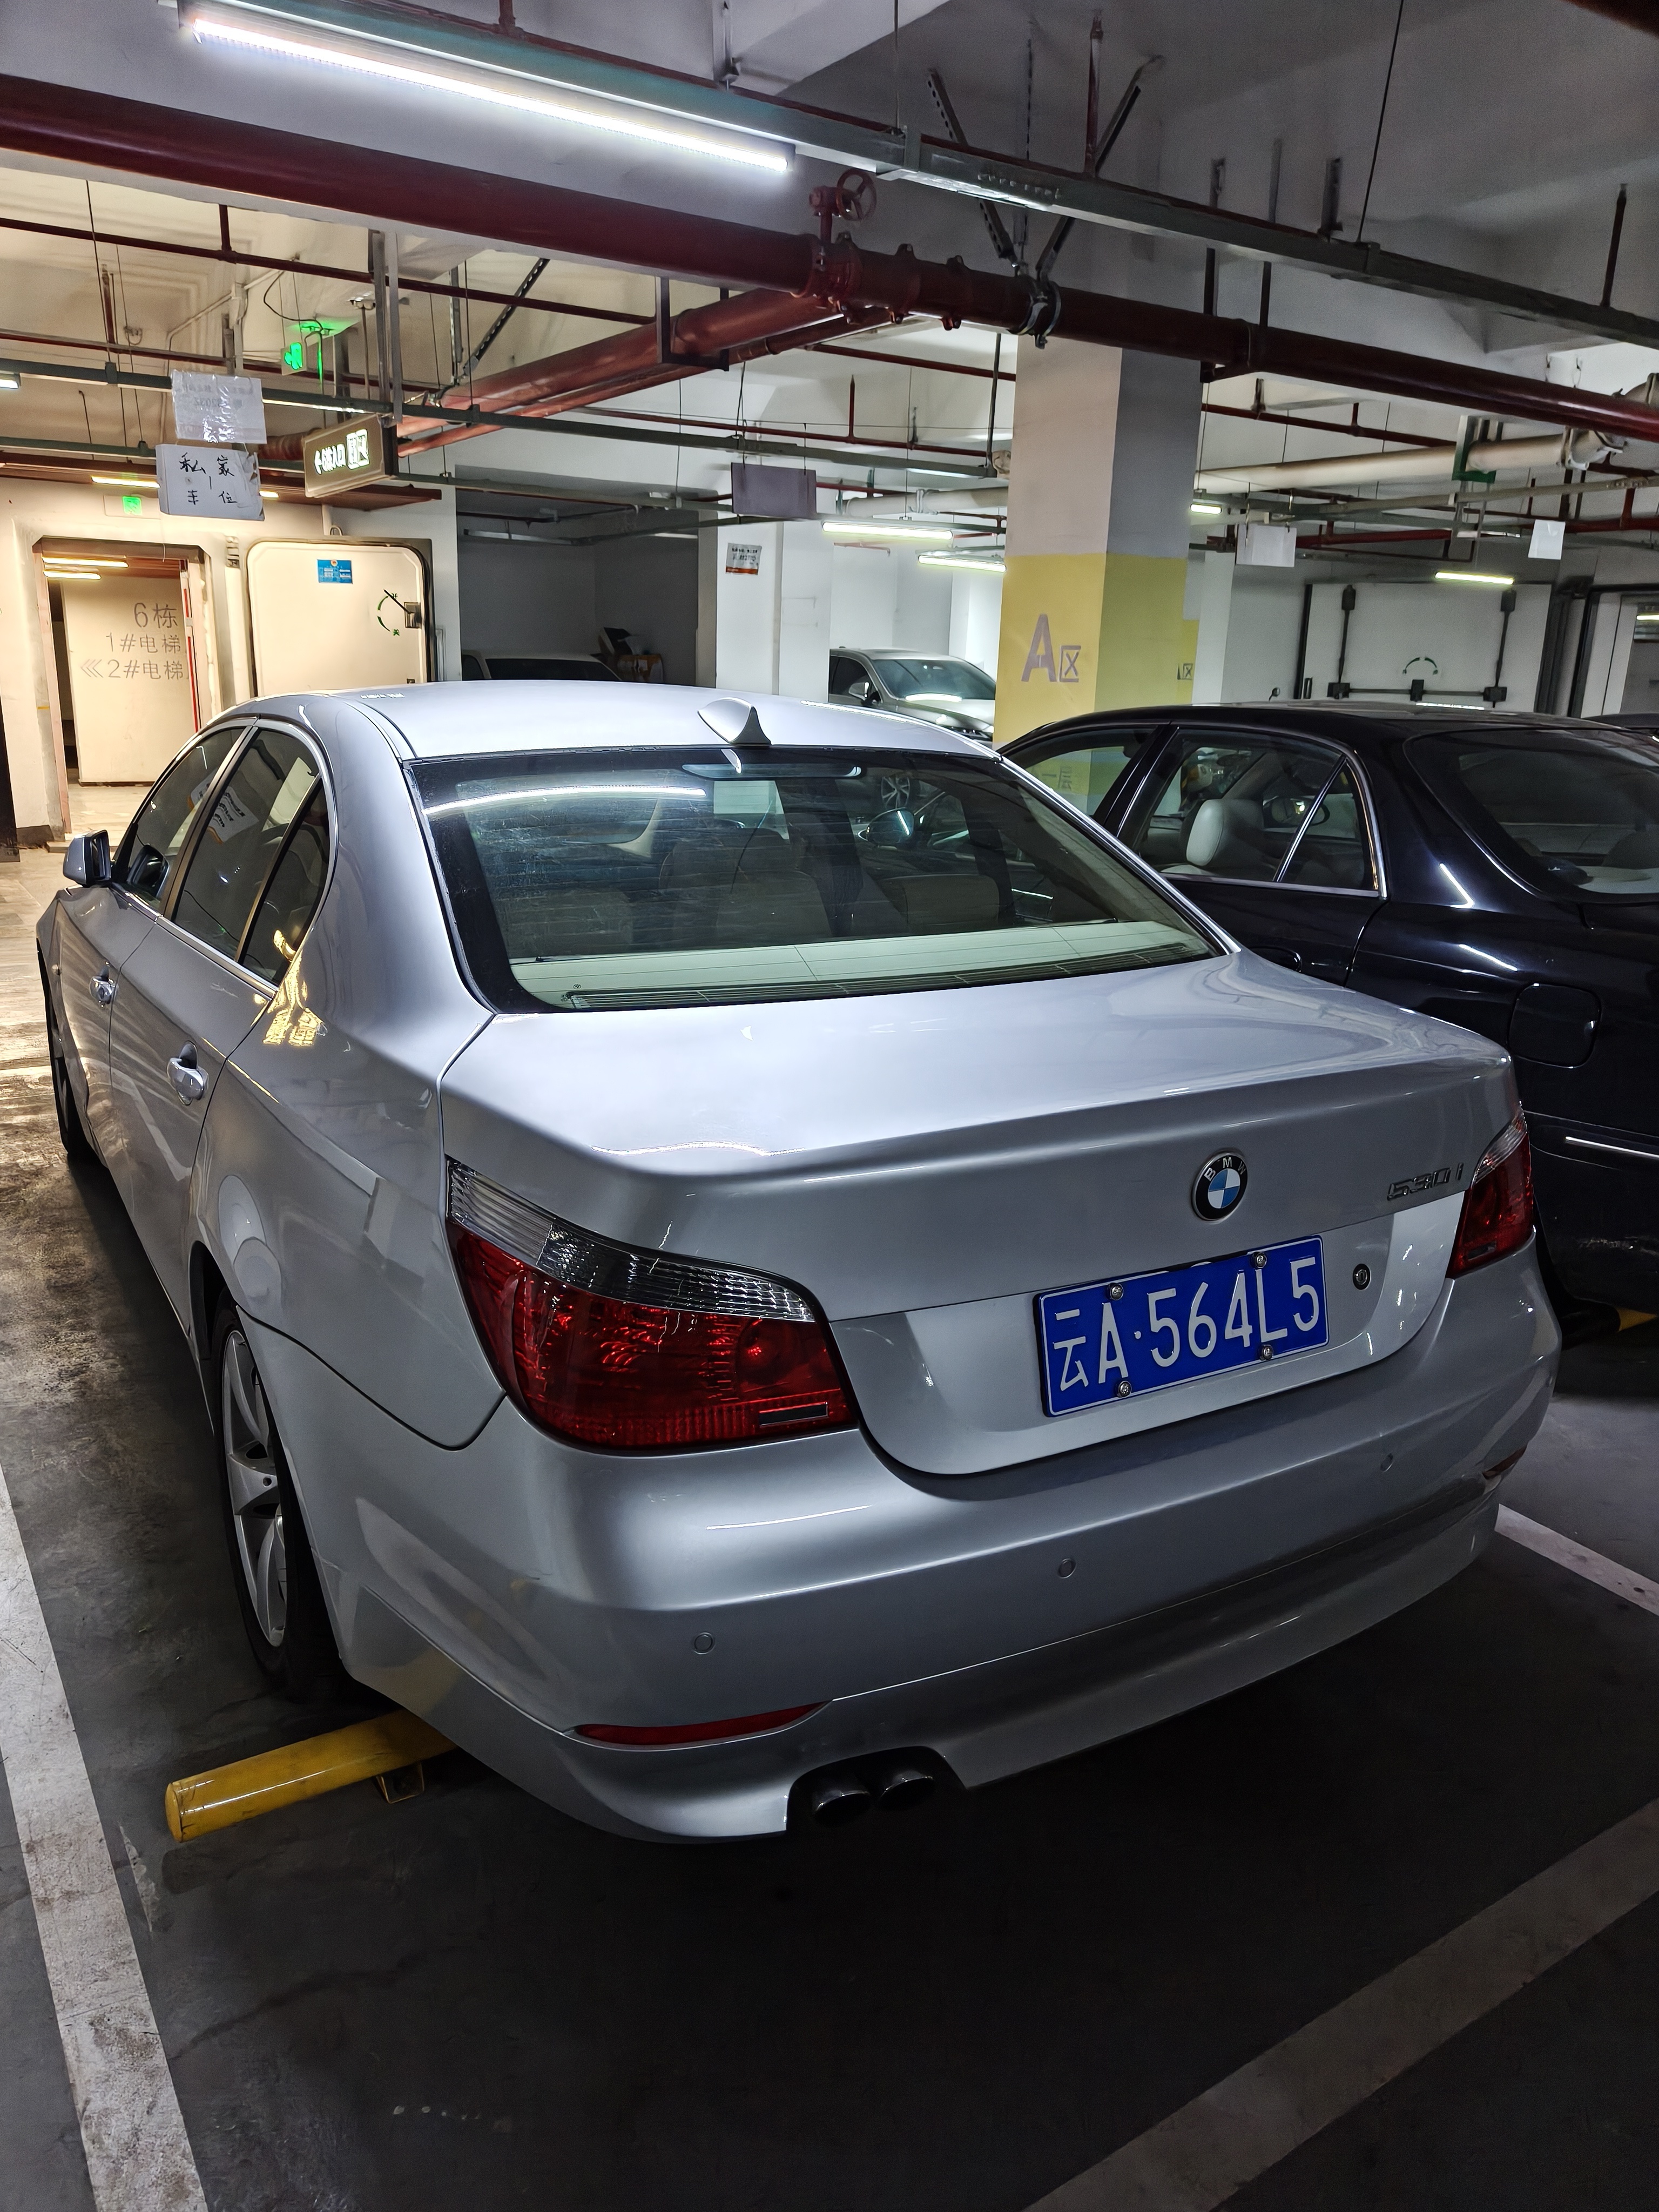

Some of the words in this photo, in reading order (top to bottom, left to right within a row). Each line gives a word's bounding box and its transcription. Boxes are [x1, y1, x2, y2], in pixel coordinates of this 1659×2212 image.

[134, 602, 178, 629] 6栋
[106, 632, 186, 654] 1#电梯
[1021, 613, 1081, 683] A区
[107, 659, 189, 680] 2#电梯
[1204, 1157, 1246, 1181] BMW
